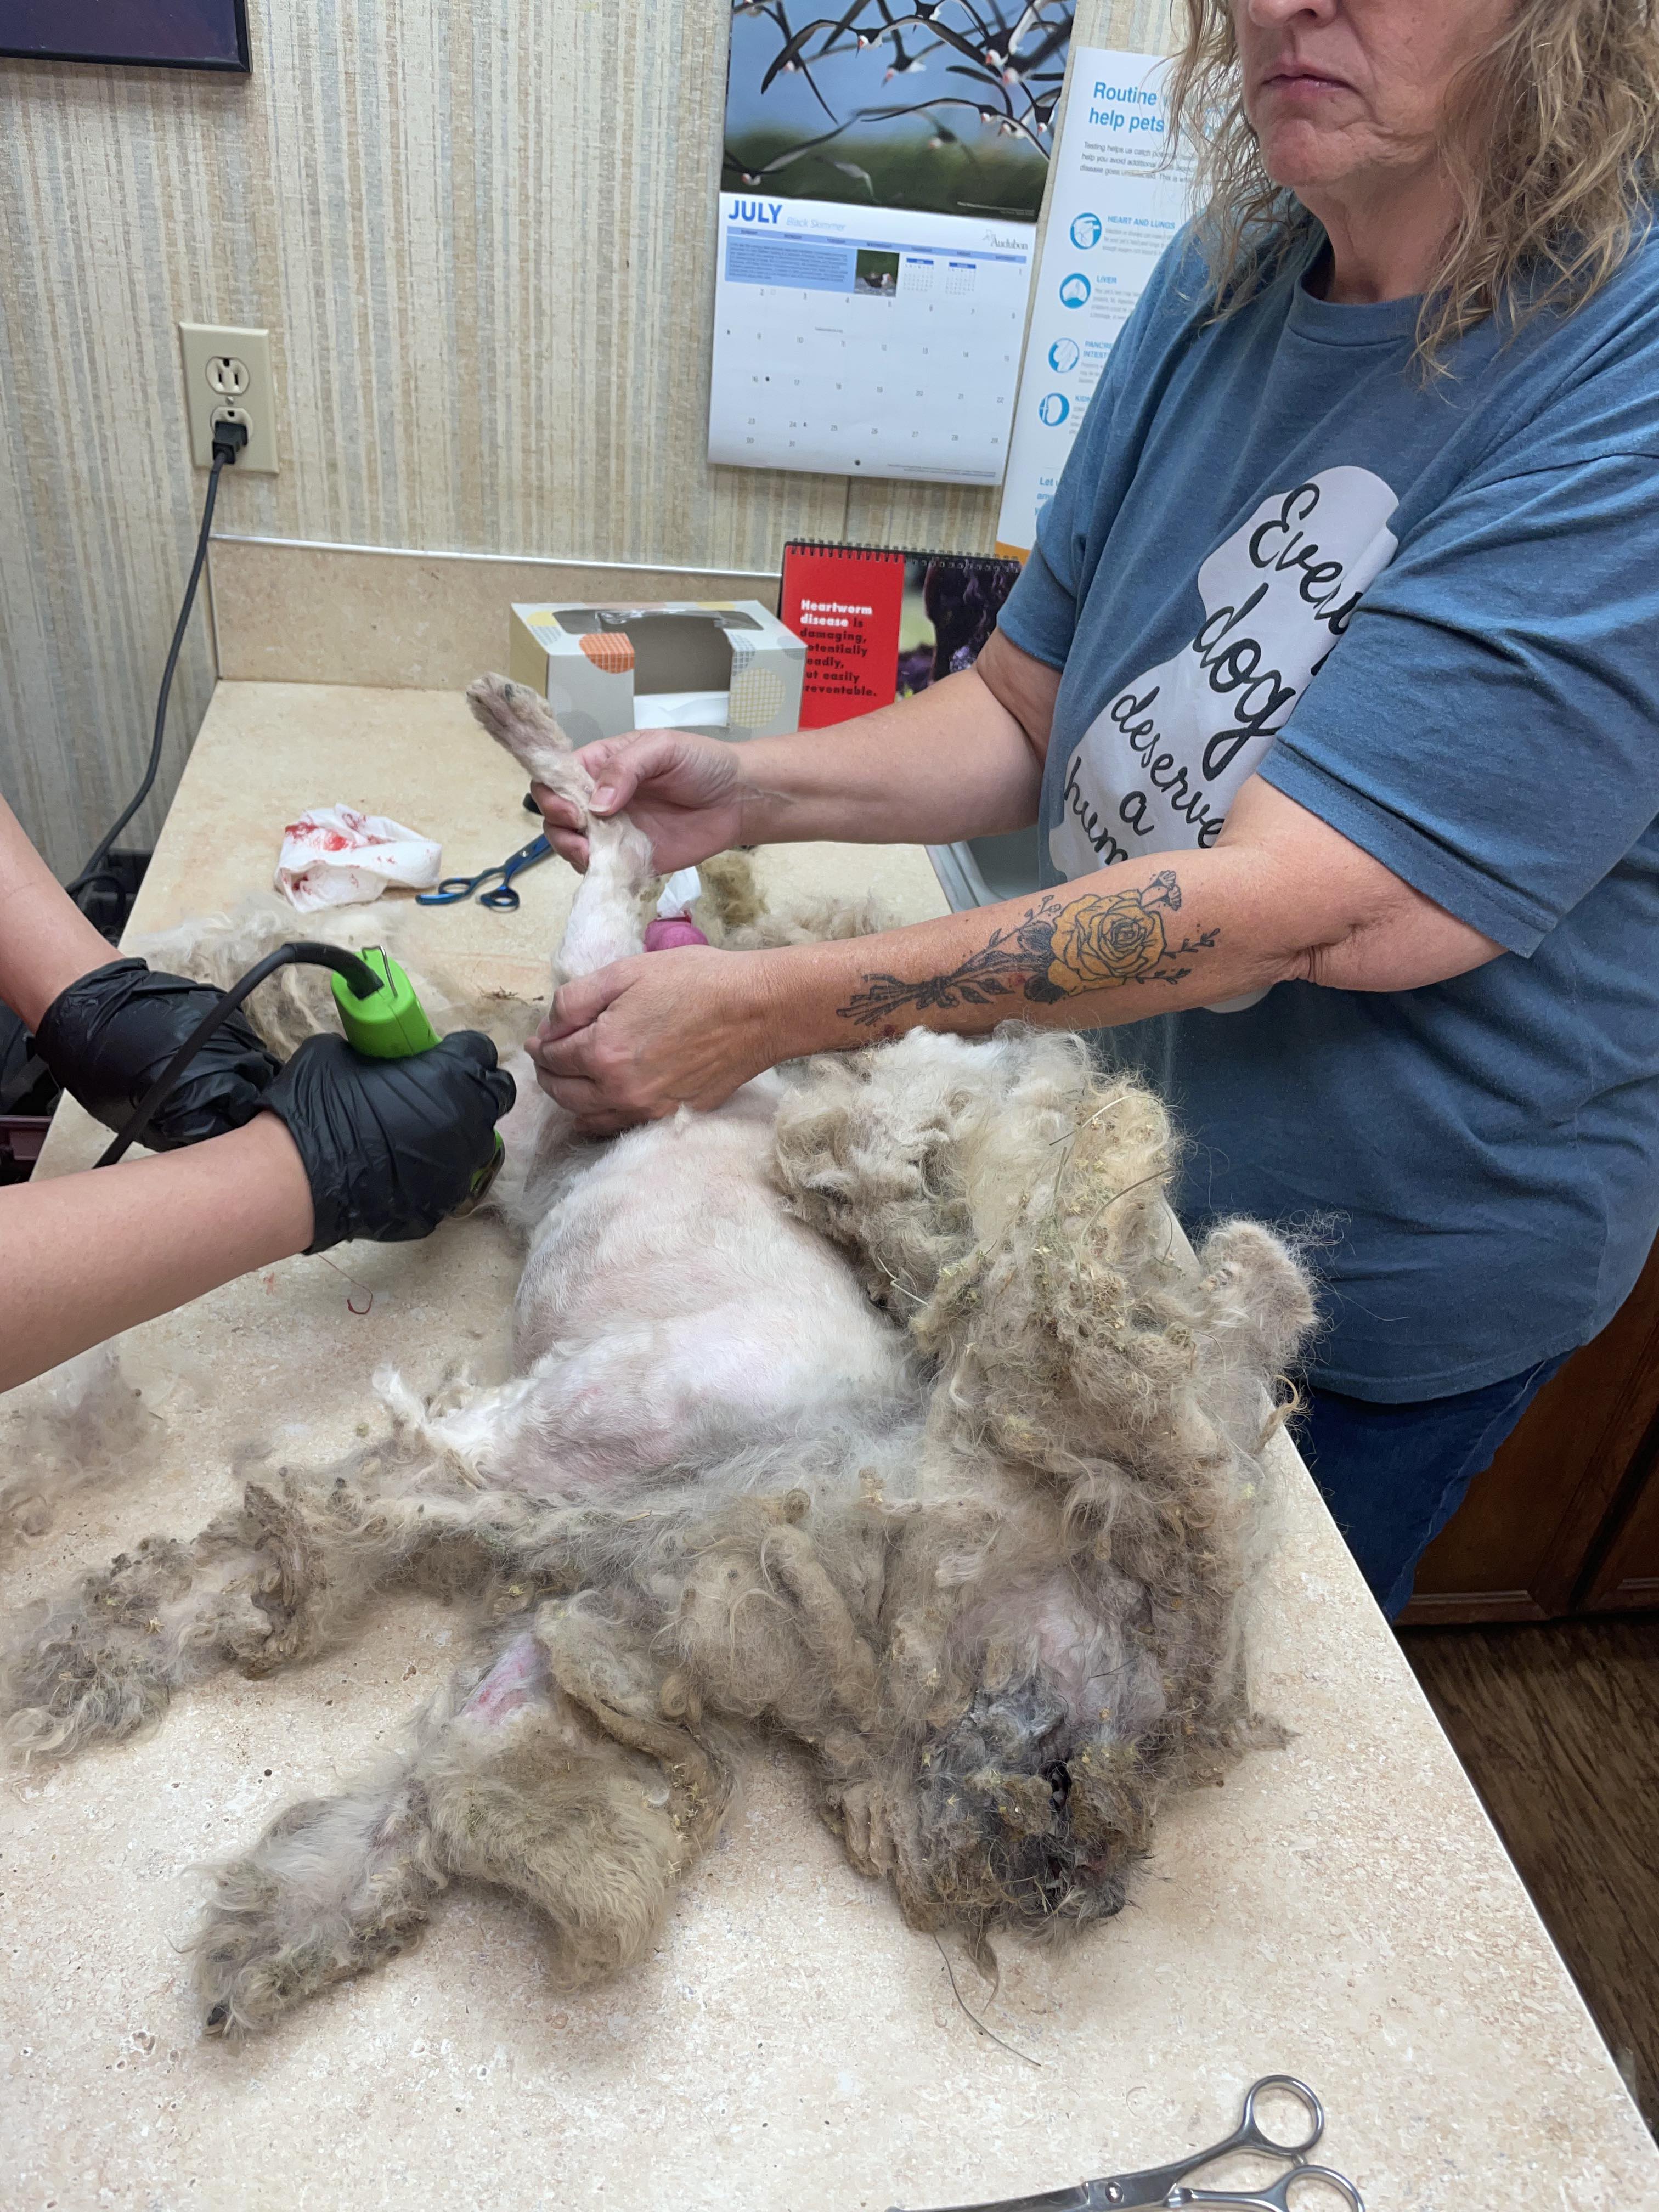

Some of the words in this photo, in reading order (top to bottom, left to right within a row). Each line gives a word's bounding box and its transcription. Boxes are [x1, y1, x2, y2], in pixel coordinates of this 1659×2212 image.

[1093, 81, 1158, 106] Routine
[1088, 106, 1125, 132] help
[1128, 115, 1164, 133] pets
[1084, 140, 1106, 153] Testing
[1107, 144, 1124, 154] helps
[1081, 152, 1096, 162] help
[1096, 155, 1109, 163] you
[1079, 163, 1103, 173] disease
[729, 200, 783, 224] JULY
[786, 217, 808, 229] Black
[1107, 215, 1132, 225] HEART
[1133, 218, 1149, 227] AND
[1150, 219, 1176, 230] LUNGS
[990, 234, 1029, 250] Audubon
[1096, 275, 1118, 285] LIVER
[1083, 350, 1109, 358] INTEST
[1039, 476, 1053, 487] Let
[800, 599, 873, 616] Heartworm
[800, 613, 849, 628] disease
[853, 617, 864, 628] is
[800, 627, 867, 644] damaging,
[807, 643, 868, 658] otentially
[806, 656, 844, 670] eadly,
[805, 670, 818, 679] ut
[823, 671, 860, 684] easily
[1192, 582, 1297, 782] dog
[804, 684, 877, 697] reventable.
[1119, 790, 1155, 837] a
